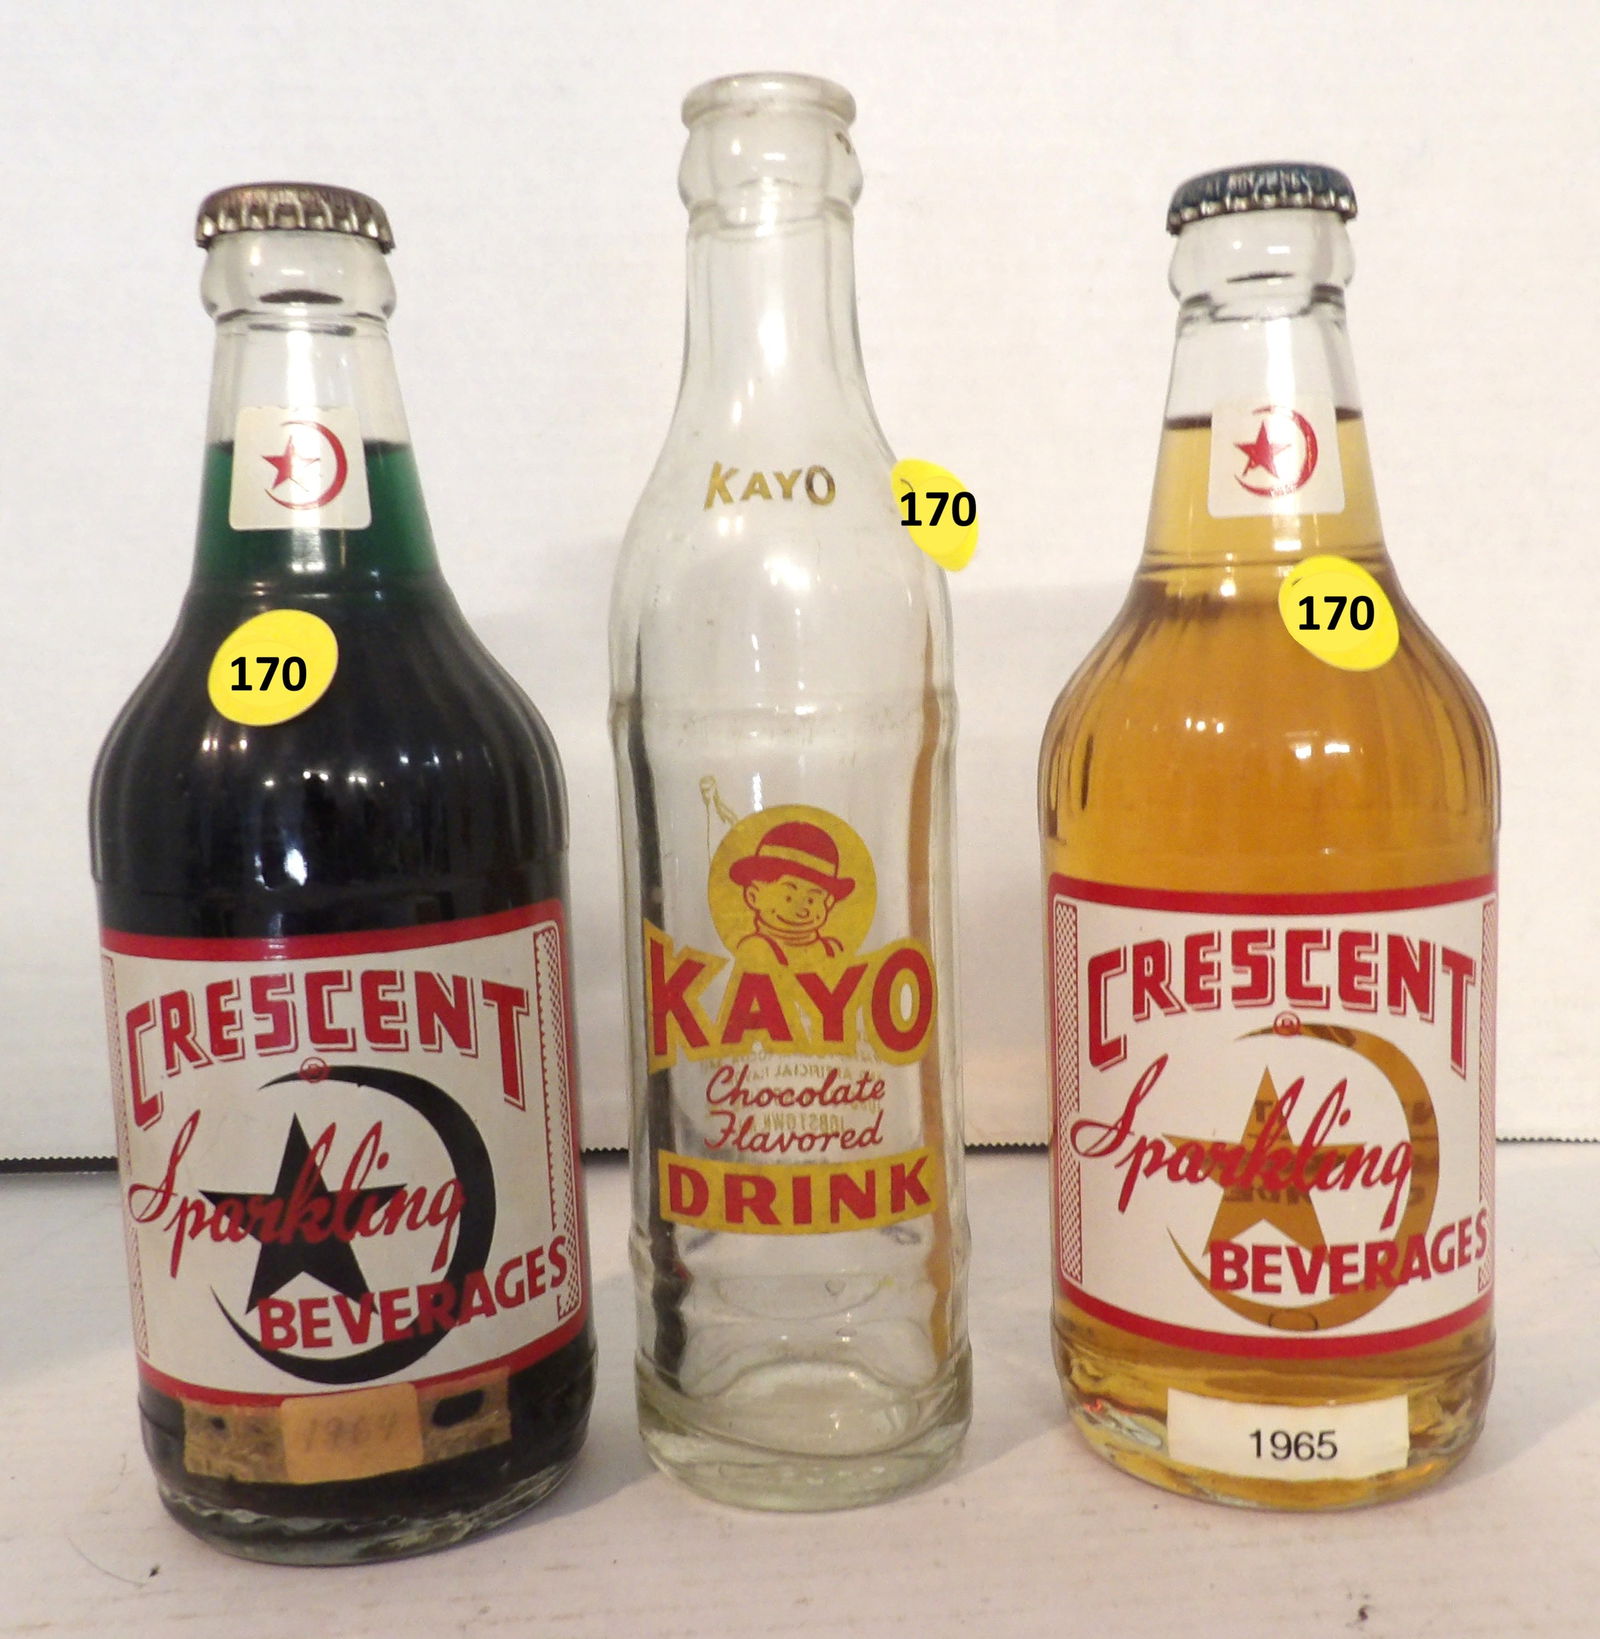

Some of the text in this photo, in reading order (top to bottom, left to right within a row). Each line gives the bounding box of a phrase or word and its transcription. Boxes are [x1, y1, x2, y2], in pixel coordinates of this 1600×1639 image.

[703, 460, 836, 511] KAYO
[126, 969, 529, 1130] CRESCENT
[649, 937, 934, 1059] KAYO
[1087, 928, 1477, 1081] CRESCENT
[703, 1108, 885, 1154] Flavored
[705, 1063, 886, 1108] Chocolate
[128, 1108, 467, 1279] Sparkling
[668, 1155, 932, 1226] DRINK
[1069, 1053, 1414, 1232] Sparkling
[256, 1235, 568, 1352] BEVERAGES
[1209, 1206, 1489, 1295] BEVERAGES
[1248, 1428, 1339, 1461] 1965
